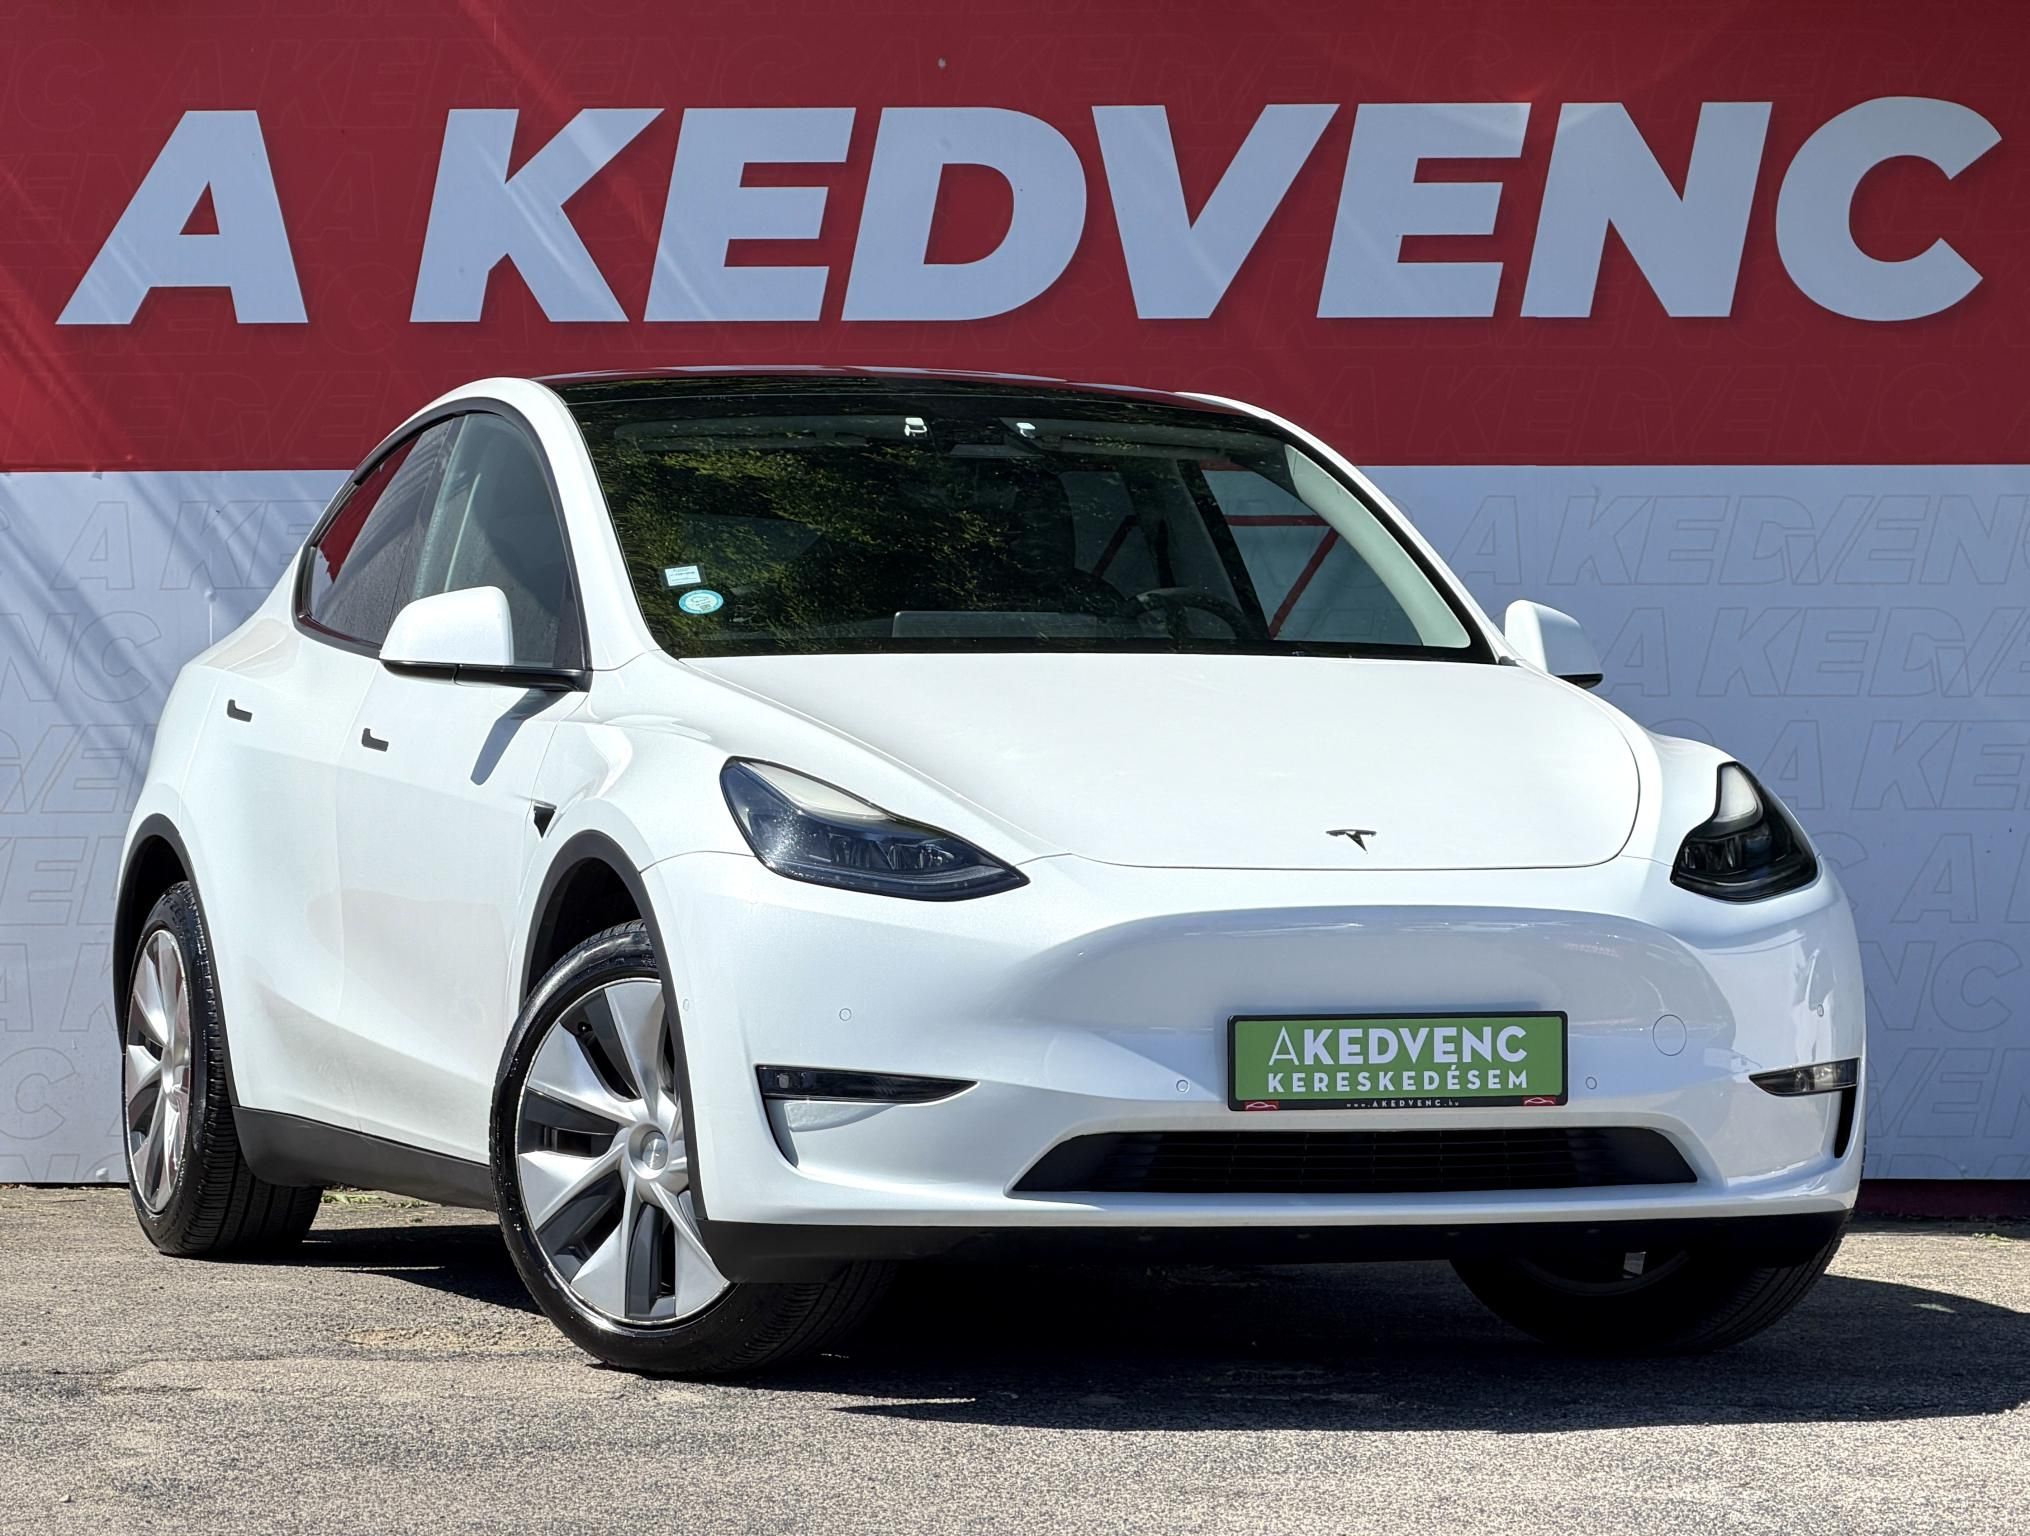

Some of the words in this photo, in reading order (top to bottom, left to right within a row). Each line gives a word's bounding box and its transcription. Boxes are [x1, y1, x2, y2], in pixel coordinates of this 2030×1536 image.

[55, 109, 310, 325] A
[409, 96, 2003, 324] KEDVENC
[50, 500, 135, 590] A
[1546, 494, 2030, 586] KEDVEN
[1267, 1065, 1528, 1093] KERESKEDÉSEM
